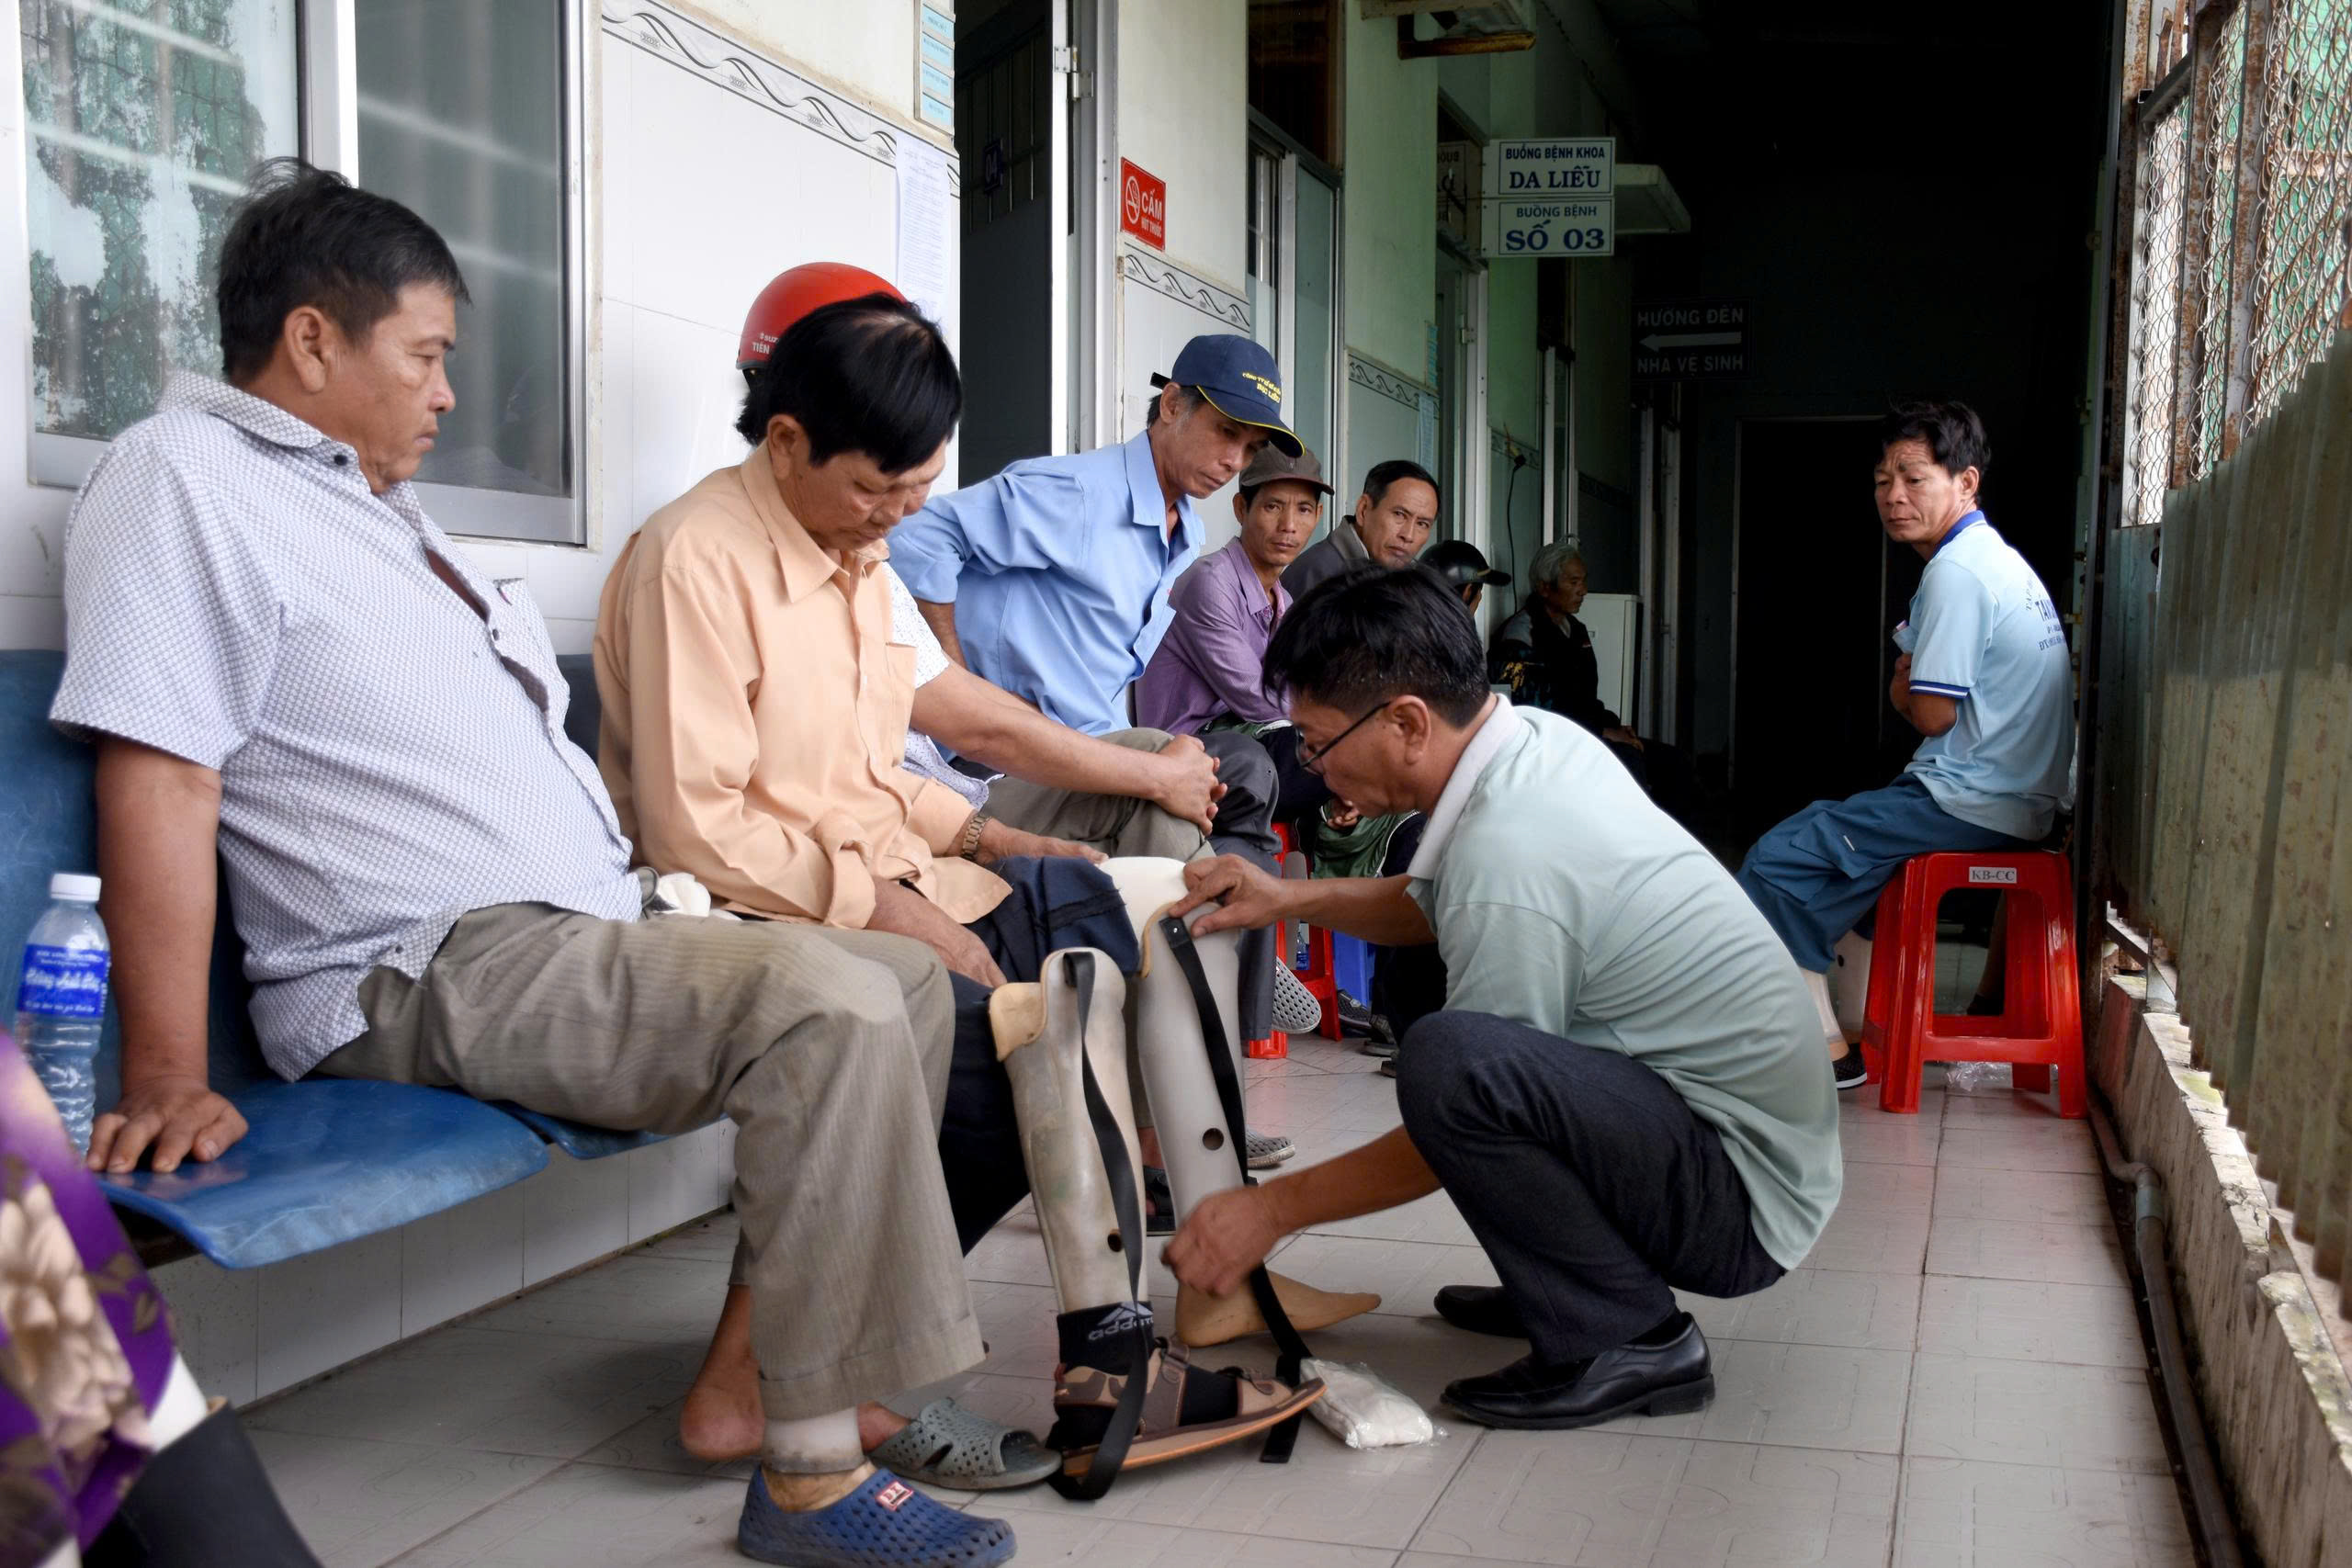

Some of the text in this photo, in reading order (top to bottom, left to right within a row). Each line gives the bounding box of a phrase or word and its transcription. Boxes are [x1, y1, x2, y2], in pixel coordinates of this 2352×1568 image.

[1544, 144, 1573, 162] BỆNH
[1576, 147, 1605, 159] KHOA
[1509, 165, 1600, 189] DA LIỄU
[1141, 188, 1162, 221] CẤM
[1564, 203, 1597, 220] BỆNH
[1506, 219, 1604, 251] SỐ 03
[1704, 354, 1744, 372] SINH
[1972, 870, 2015, 881] KB-CC
